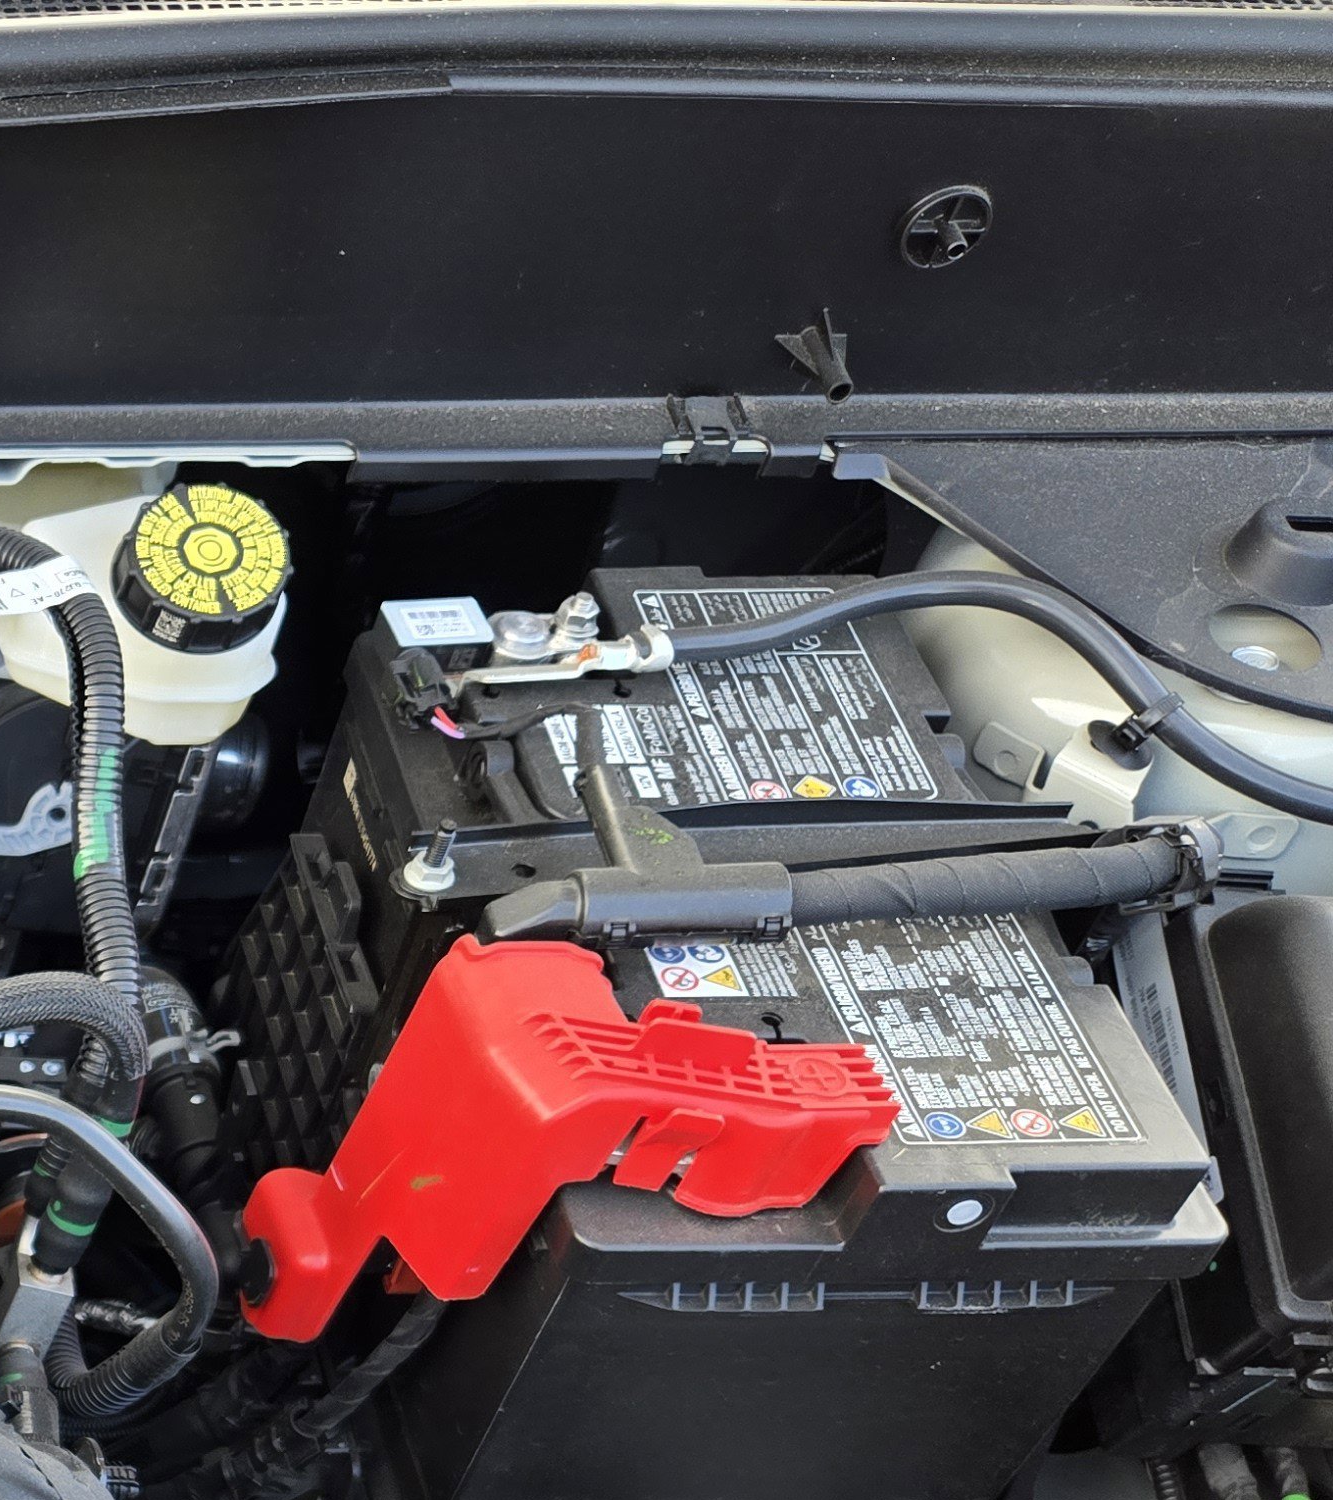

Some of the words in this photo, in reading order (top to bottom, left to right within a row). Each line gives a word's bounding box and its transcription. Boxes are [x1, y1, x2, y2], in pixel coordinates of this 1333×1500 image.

[810, 946, 864, 1021] PELIGRO/VENENO
[1025, 973, 1044, 985] LA
[1032, 985, 1053, 998] NO
[1061, 1037, 1085, 1055] PAS
[1072, 1056, 1092, 1068] NE
[1080, 1071, 1110, 1098] OPEN.
[1096, 1099, 1121, 1117] NOT
[1108, 1119, 1129, 1132] DO
